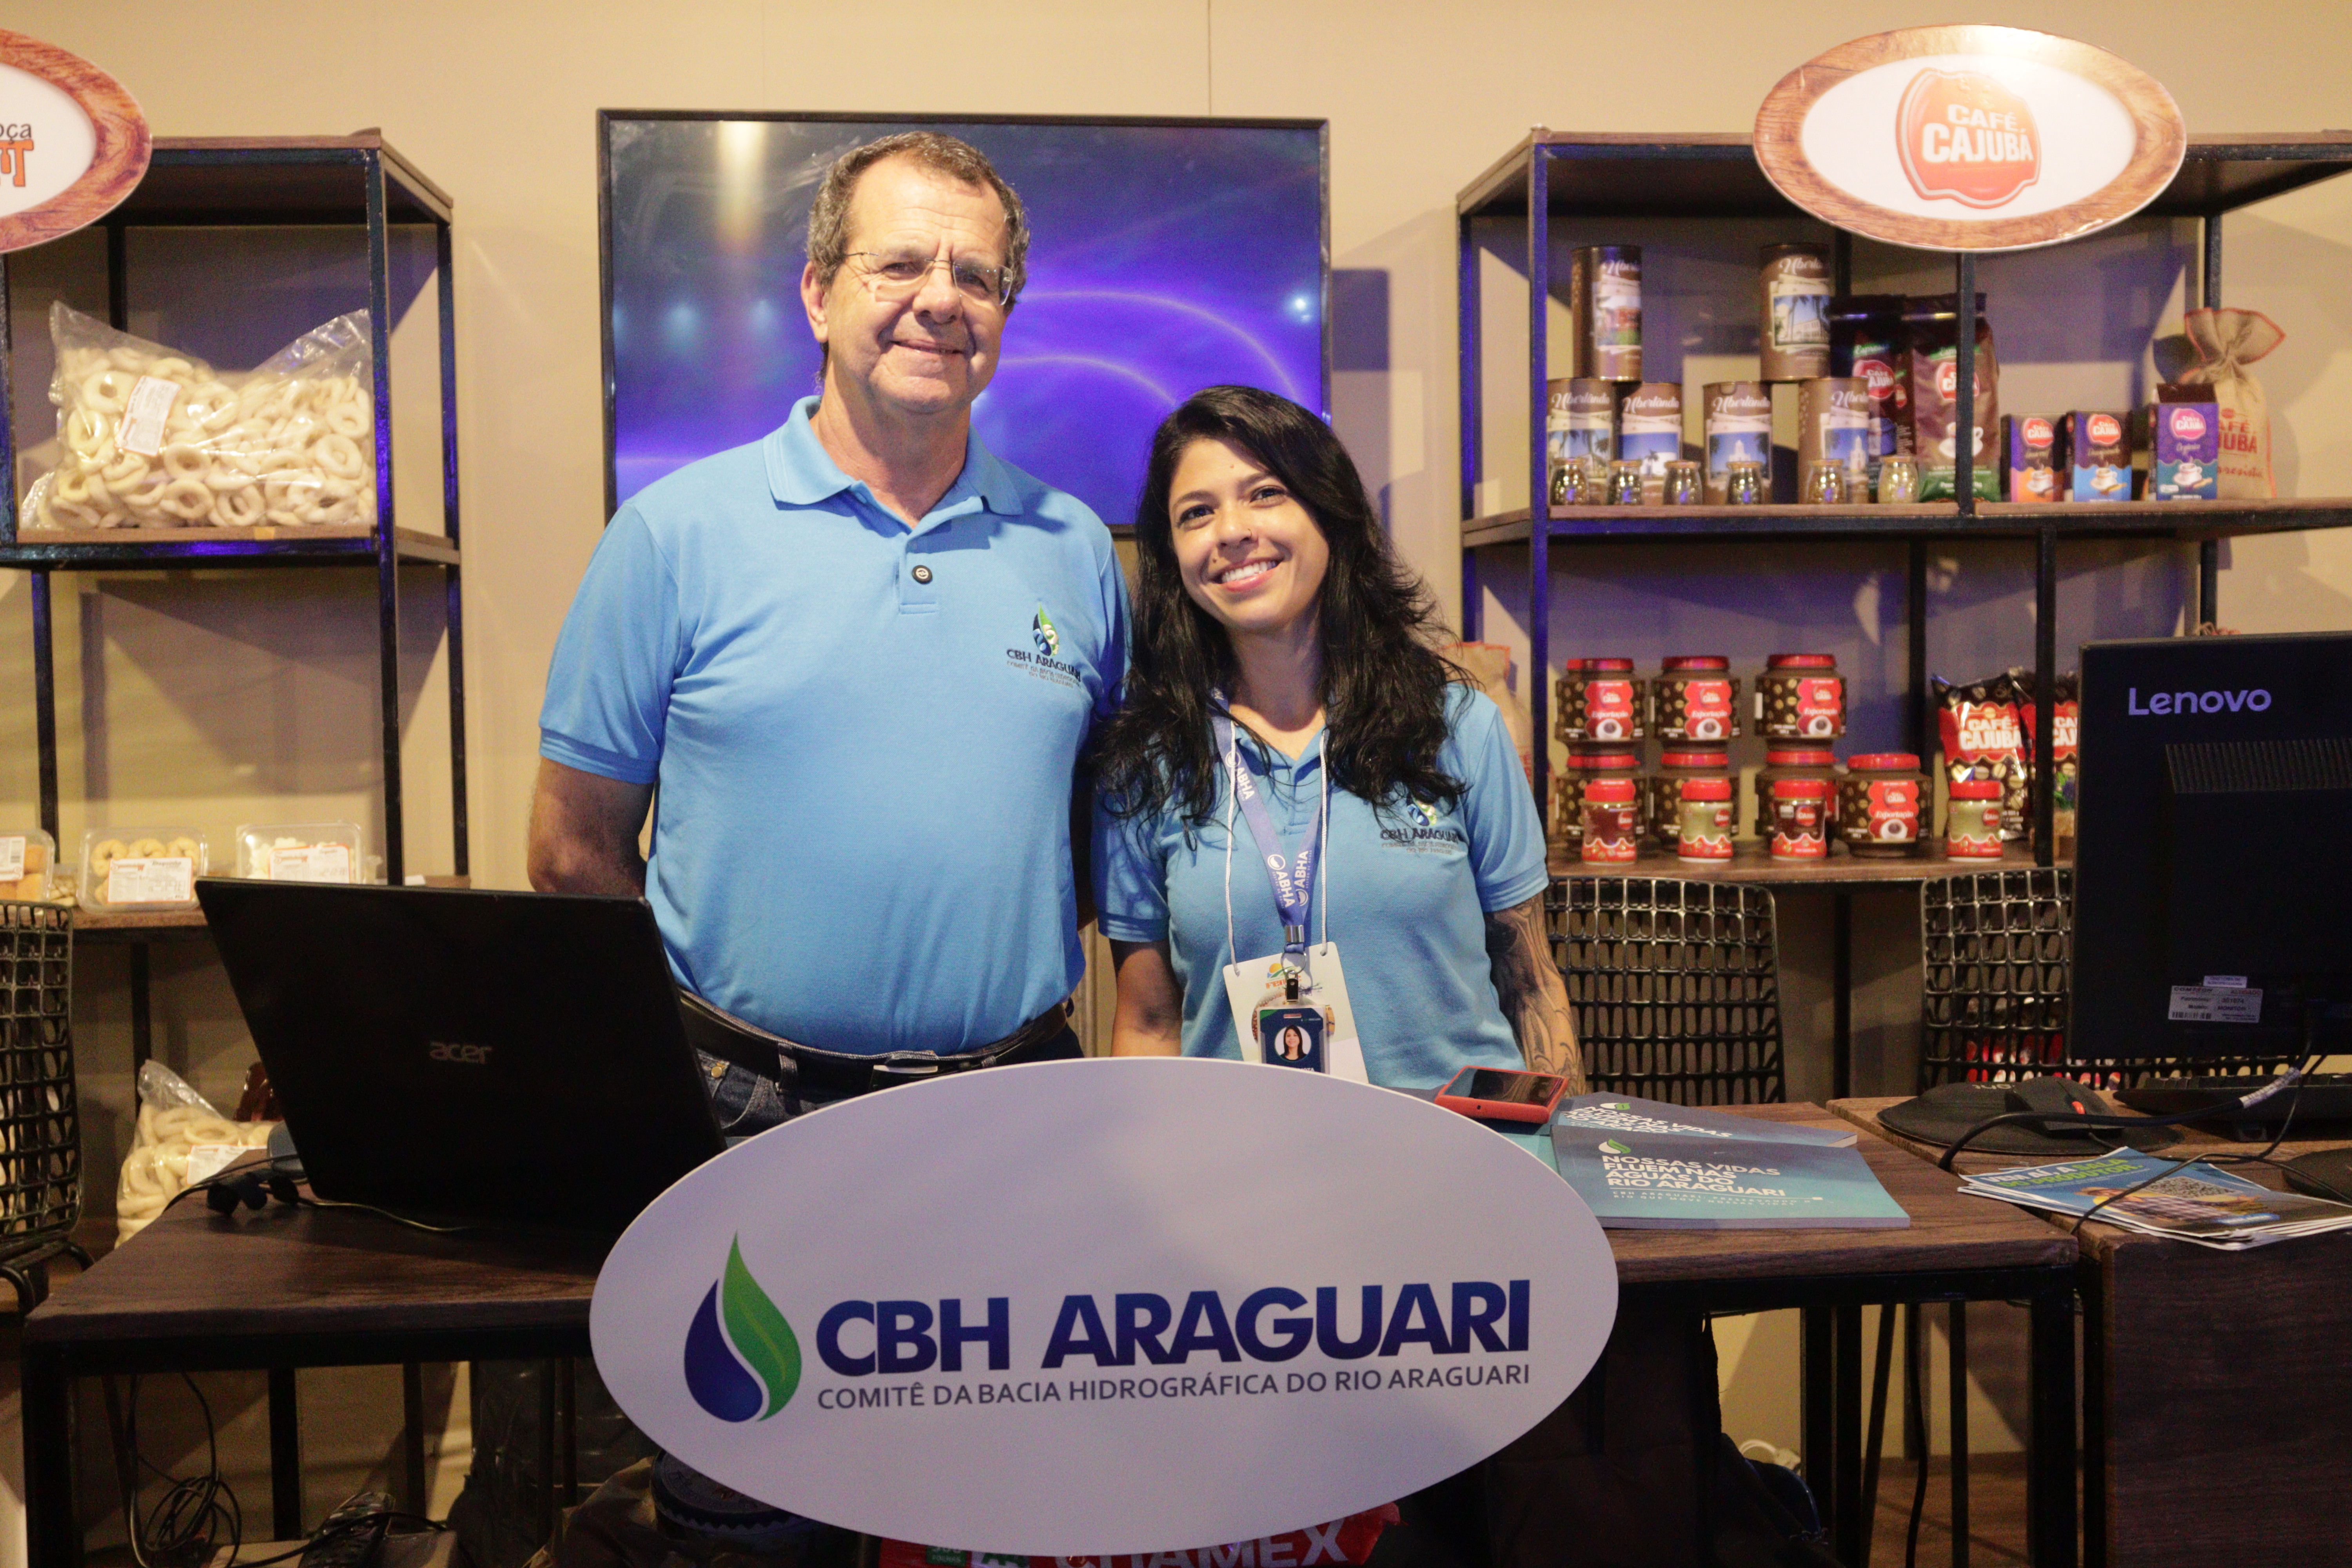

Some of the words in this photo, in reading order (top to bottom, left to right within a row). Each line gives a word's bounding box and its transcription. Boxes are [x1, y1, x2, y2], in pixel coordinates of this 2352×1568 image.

[1946, 103, 2018, 132] CAFÉ
[1922, 122, 2034, 163] CAJUBÁ
[1006, 648, 1032, 662] CBH
[2128, 687, 2272, 715] Lenovo
[1968, 716, 2012, 731] CAFÉ
[1237, 767, 1255, 800] ABHA
[1294, 850, 1309, 889] ABHA
[1276, 871, 1296, 908] ABHA
[429, 1042, 493, 1064] acer
[1584, 1106, 1669, 1125] NOSSAS
[1672, 1123, 1733, 1138] VIDAS
[1602, 1155, 1702, 1169] NOSSAS
[1705, 1162, 1781, 1176] VIDAS
[1603, 1162, 1681, 1174] FLUEM
[1685, 1167, 1737, 1179] NAS
[1605, 1169, 1692, 1182] ÁGUAS
[1697, 1175, 1735, 1185] DO
[1981, 1174, 2031, 1183] VEM
[2071, 1159, 2128, 1171] SALA
[1607, 1178, 1651, 1187] RIO
[1656, 1180, 1786, 1196] ARAGUARI
[816, 1297, 1010, 1377] CBH
[1040, 1279, 1530, 1369] ARAGUARI
[817, 1382, 925, 1410] COMITÊ
[934, 1385, 973, 1405] DA
[978, 1382, 1061, 1404] BACIA
[1069, 1371, 1279, 1401] HIDROGRÁFICA
[1287, 1372, 1327, 1393] DO
[1335, 1370, 1382, 1391] RIO
[1388, 1364, 1529, 1389] ARAGUARI
